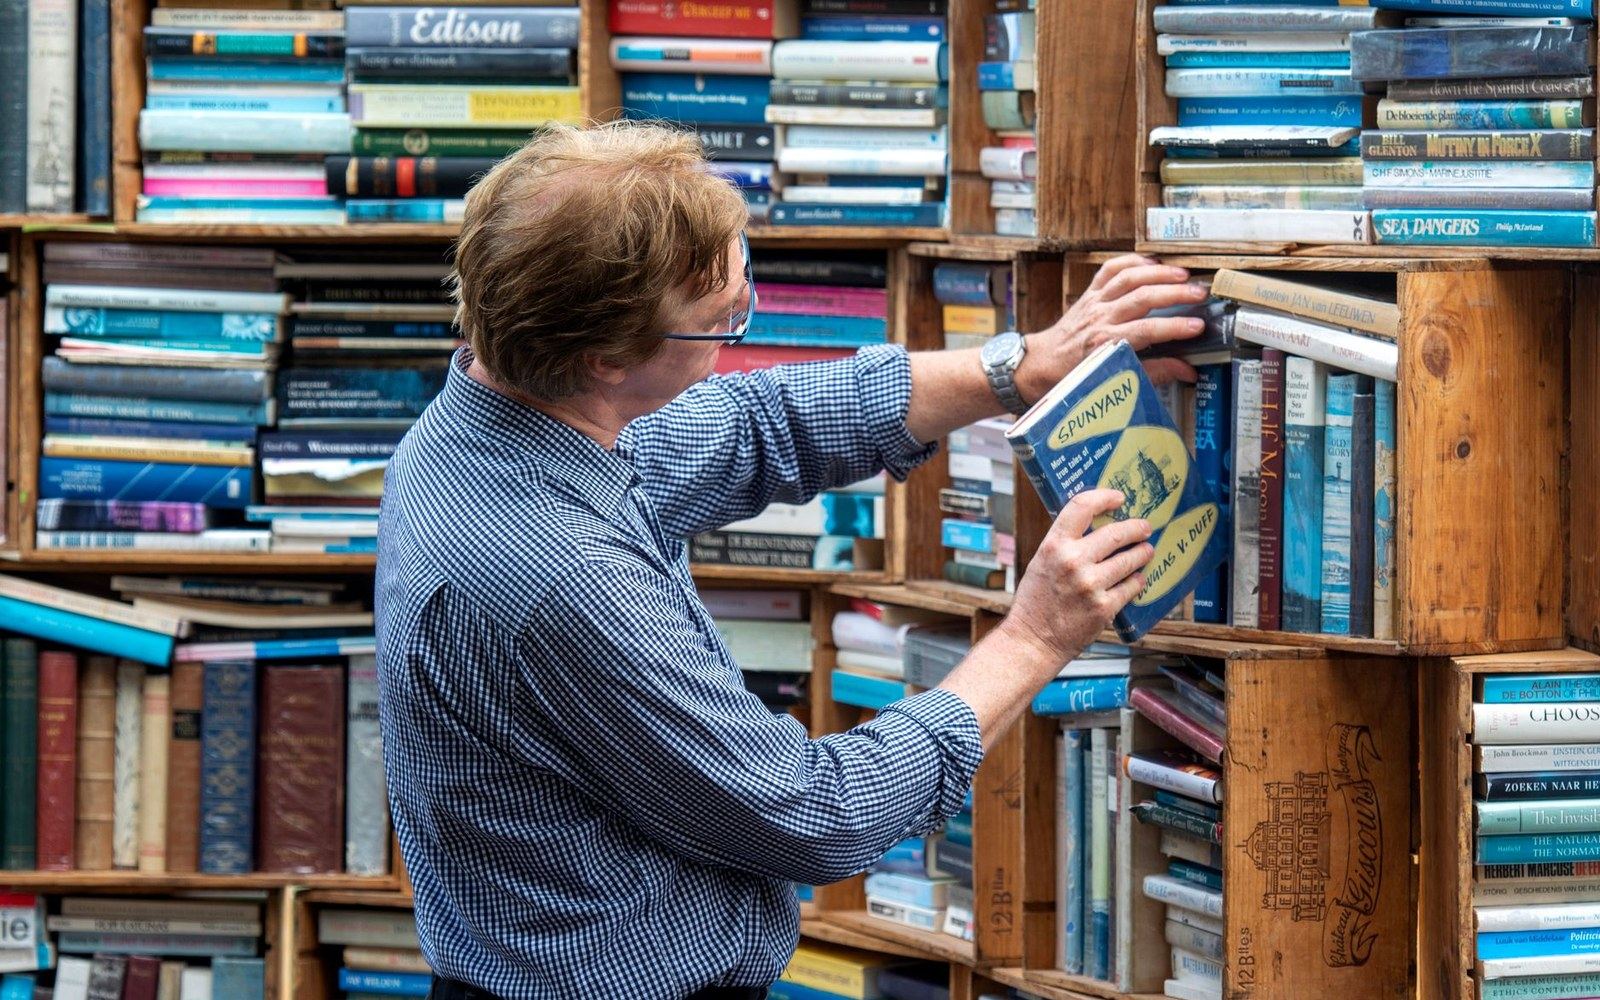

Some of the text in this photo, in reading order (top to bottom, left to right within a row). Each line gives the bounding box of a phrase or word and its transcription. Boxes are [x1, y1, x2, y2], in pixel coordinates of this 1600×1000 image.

[410, 8, 524, 43] Edison
[1486, 80, 1529, 98] Spanish
[1382, 134, 1406, 145] BILL
[1426, 134, 1475, 157] MUTINY
[1477, 137, 1490, 157] IN
[1491, 134, 1529, 157] FORCE
[1530, 132, 1542, 157] X
[1369, 145, 1417, 157] GLENTON
[1381, 218, 1409, 236] SEA
[1413, 218, 1480, 236] DANGERS
[1255, 286, 1376, 325] Kapitein JAN van LEEUWEN
[1058, 378, 1133, 443] SPUNYARN
[1288, 410, 1305, 418] Power
[1328, 448, 1350, 457] GLORY
[1050, 455, 1066, 470] More
[1056, 446, 1090, 480] true tales of
[1061, 441, 1113, 489] heroism and villainy
[1067, 481, 1085, 499] at sea
[1177, 538, 1189, 555] V.
[1189, 508, 1215, 542] DUFF
[769, 552, 808, 567] TURNER
[1532, 680, 1561, 690] ALAIN
[1565, 679, 1582, 689] THE
[1502, 691, 1516, 699] DE
[1519, 690, 1561, 699] BOTTON
[1563, 689, 1576, 698] OF
[1493, 750, 1511, 759] John
[1512, 749, 1548, 758] Brockman
[1505, 783, 1547, 792] ZOEKEN
[1551, 782, 1580, 792] NAAR
[1531, 810, 1556, 825] The
[1532, 836, 1551, 846] THE
[1532, 848, 1551, 858] THE
[1330, 909, 1351, 967] Château
[1348, 783, 1377, 915] Giscours
[1484, 863, 1525, 879] HERBERT
[1528, 862, 1574, 878] MARCUSE
[1514, 886, 1562, 895] GESCHIEDENIS
[1492, 975, 1600, 986] THE COMMUNICATIVE
[1492, 987, 1528, 997] ETHICS
